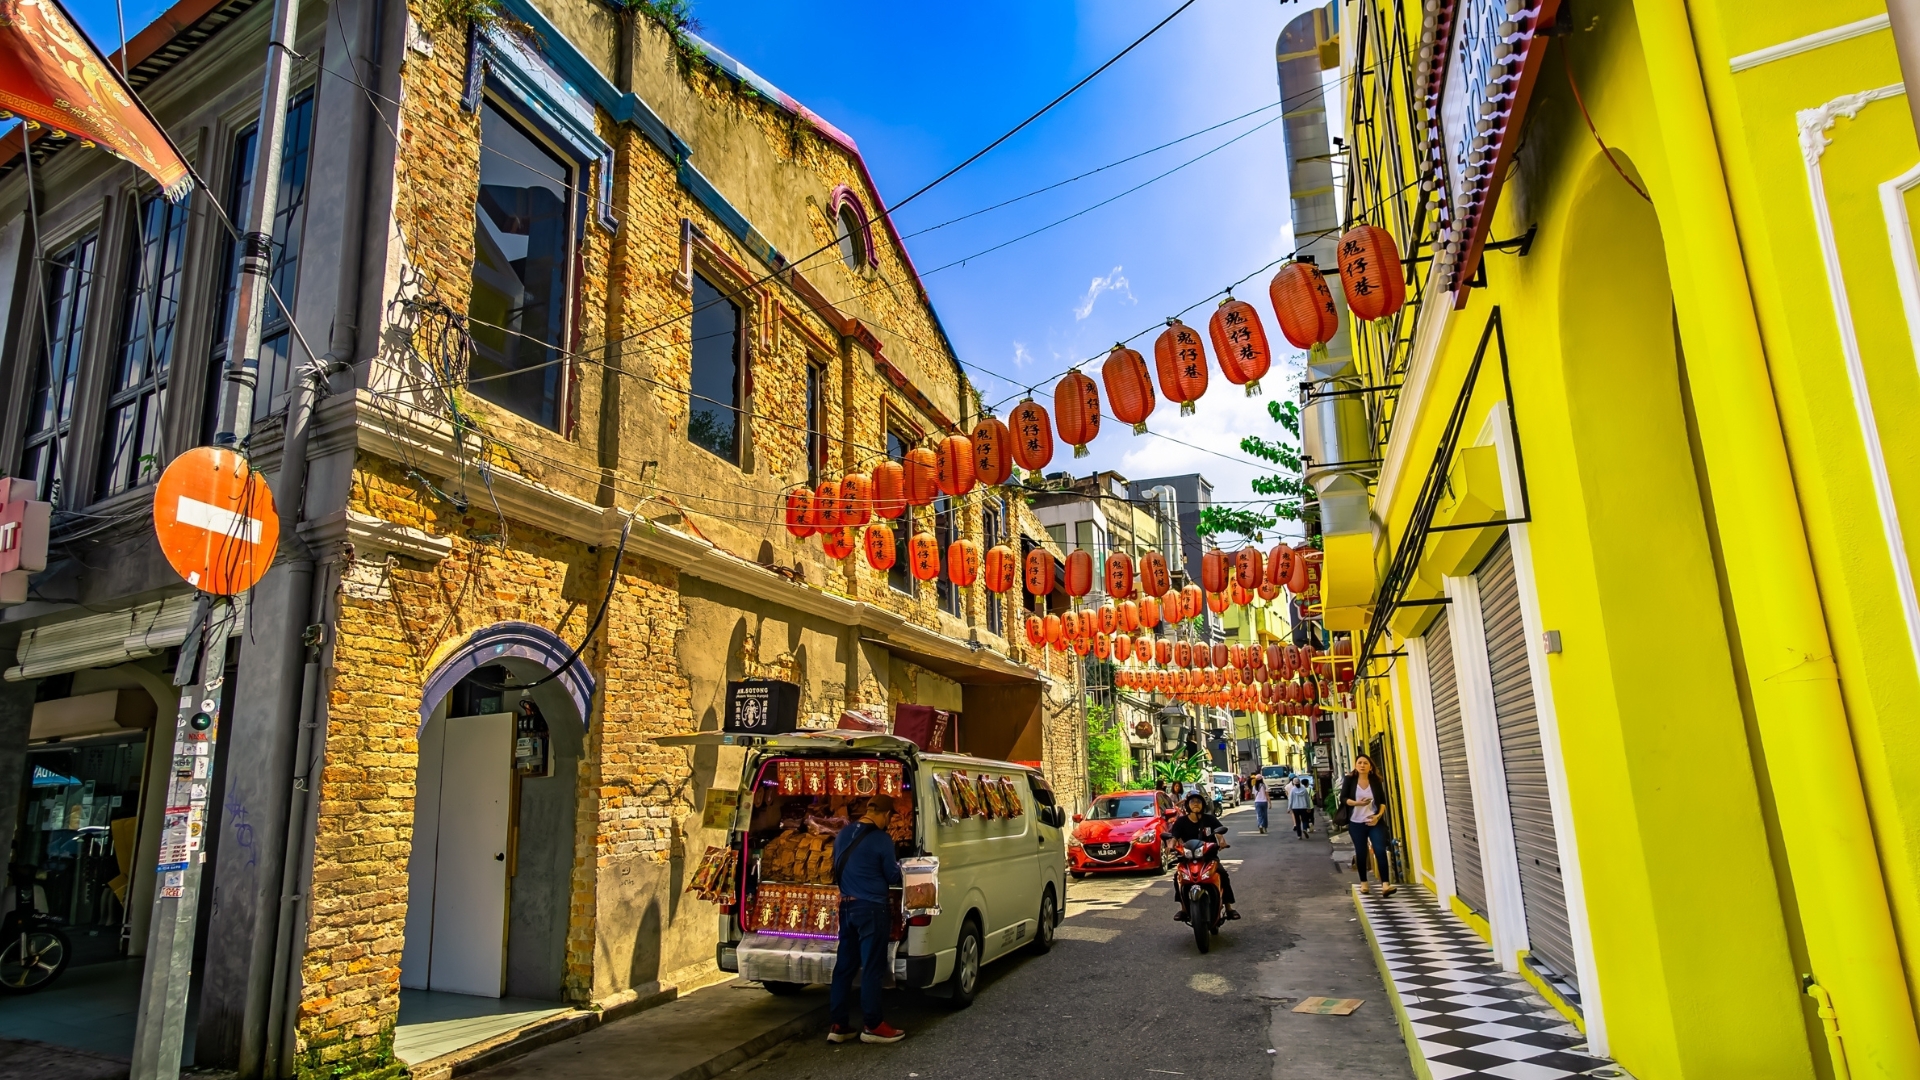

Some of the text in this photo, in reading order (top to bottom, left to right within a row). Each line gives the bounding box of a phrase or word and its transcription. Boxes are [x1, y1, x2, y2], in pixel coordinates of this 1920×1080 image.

[1342, 239, 1380, 297] 鬼仔巷
[1224, 312, 1262, 361] 鬼仔巷
[1175, 331, 1203, 378] 鬼仔巷
[1022, 410, 1044, 452] 鬼仔巷
[976, 429, 994, 471] 鬼仔巷
[820, 486, 836, 519] 鬼仔巷
[872, 530, 888, 560] 鬼仔巷
[917, 540, 932, 569] 鬼仔巷
[1028, 556, 1041, 586] 鬼仔巷
[1112, 560, 1125, 589] 鬼仔巷
[1152, 559, 1167, 587] 鬼仔巷
[1238, 553, 1250, 579] 鬼仔巷
[1280, 552, 1291, 578] 鬼仔巷
